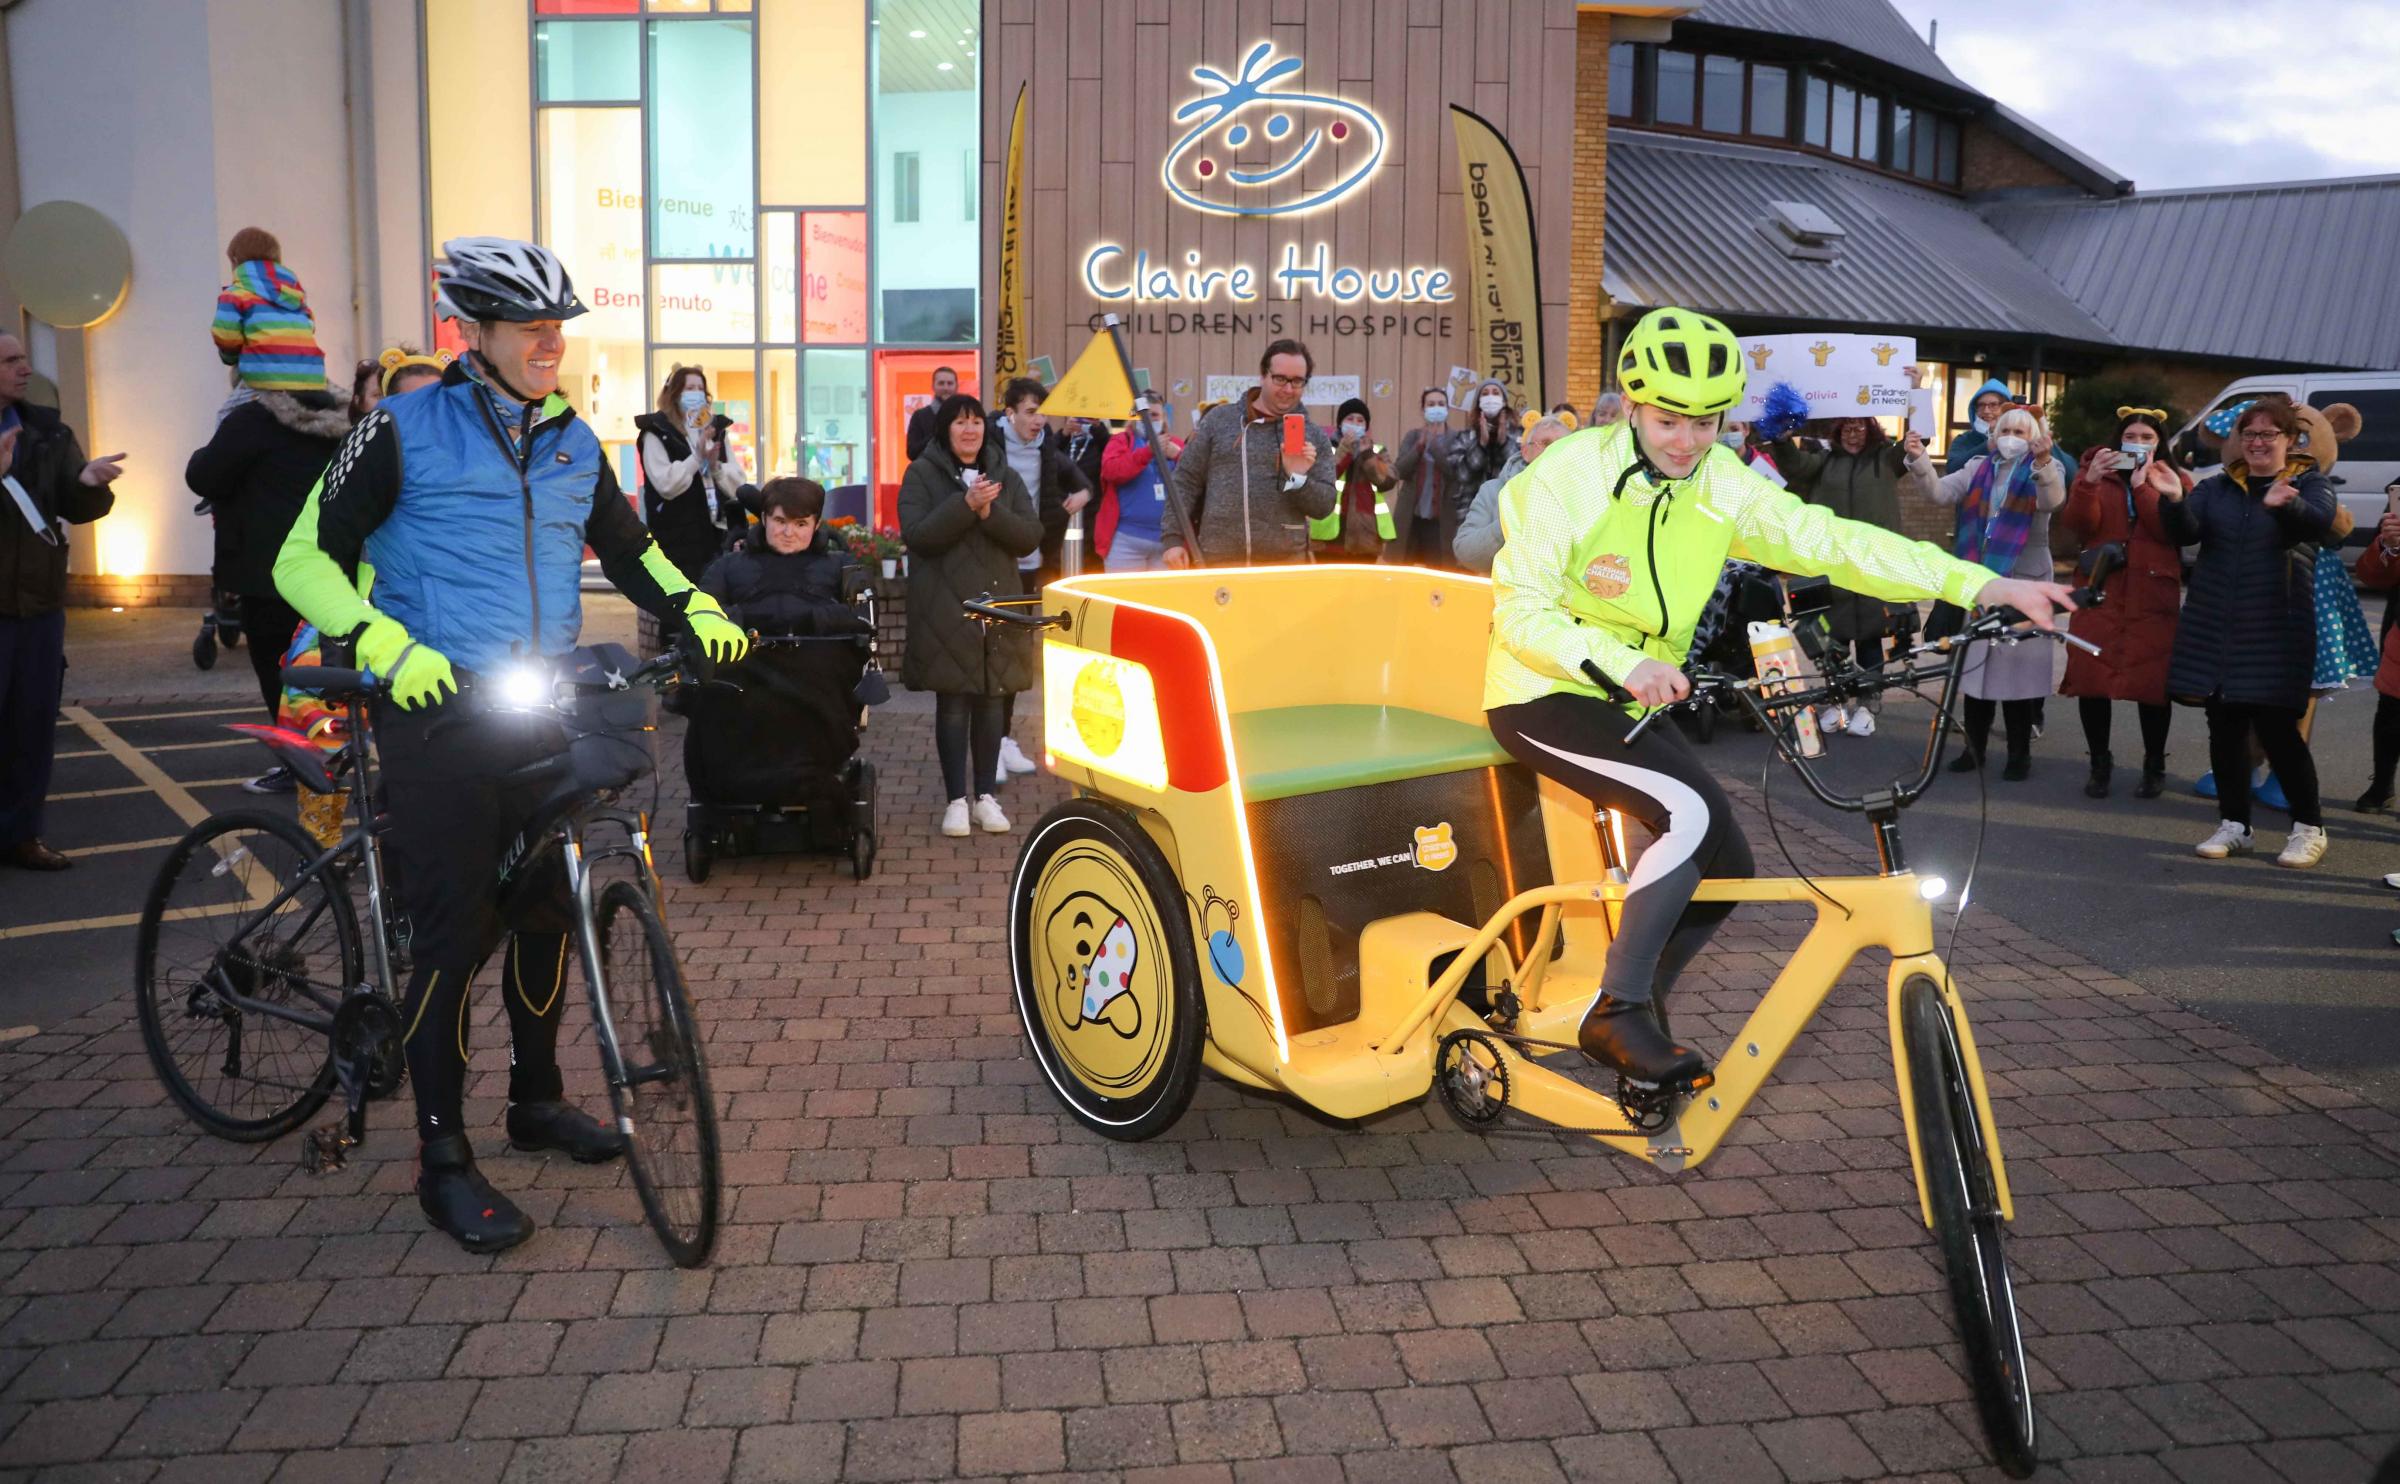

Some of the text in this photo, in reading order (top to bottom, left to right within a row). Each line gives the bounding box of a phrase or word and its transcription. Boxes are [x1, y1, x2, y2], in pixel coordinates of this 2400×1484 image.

[597, 188, 713, 217] Bieenue
[729, 204, 754, 232] 欢
[1086, 244, 1453, 301] Claire House
[594, 287, 713, 312] Benenuto
[1088, 313, 1452, 337] CHILDREN'S HOSPICE
[1805, 391, 1838, 400] Olivia
[1329, 852, 1412, 876] TOGETHER, WE CAN
